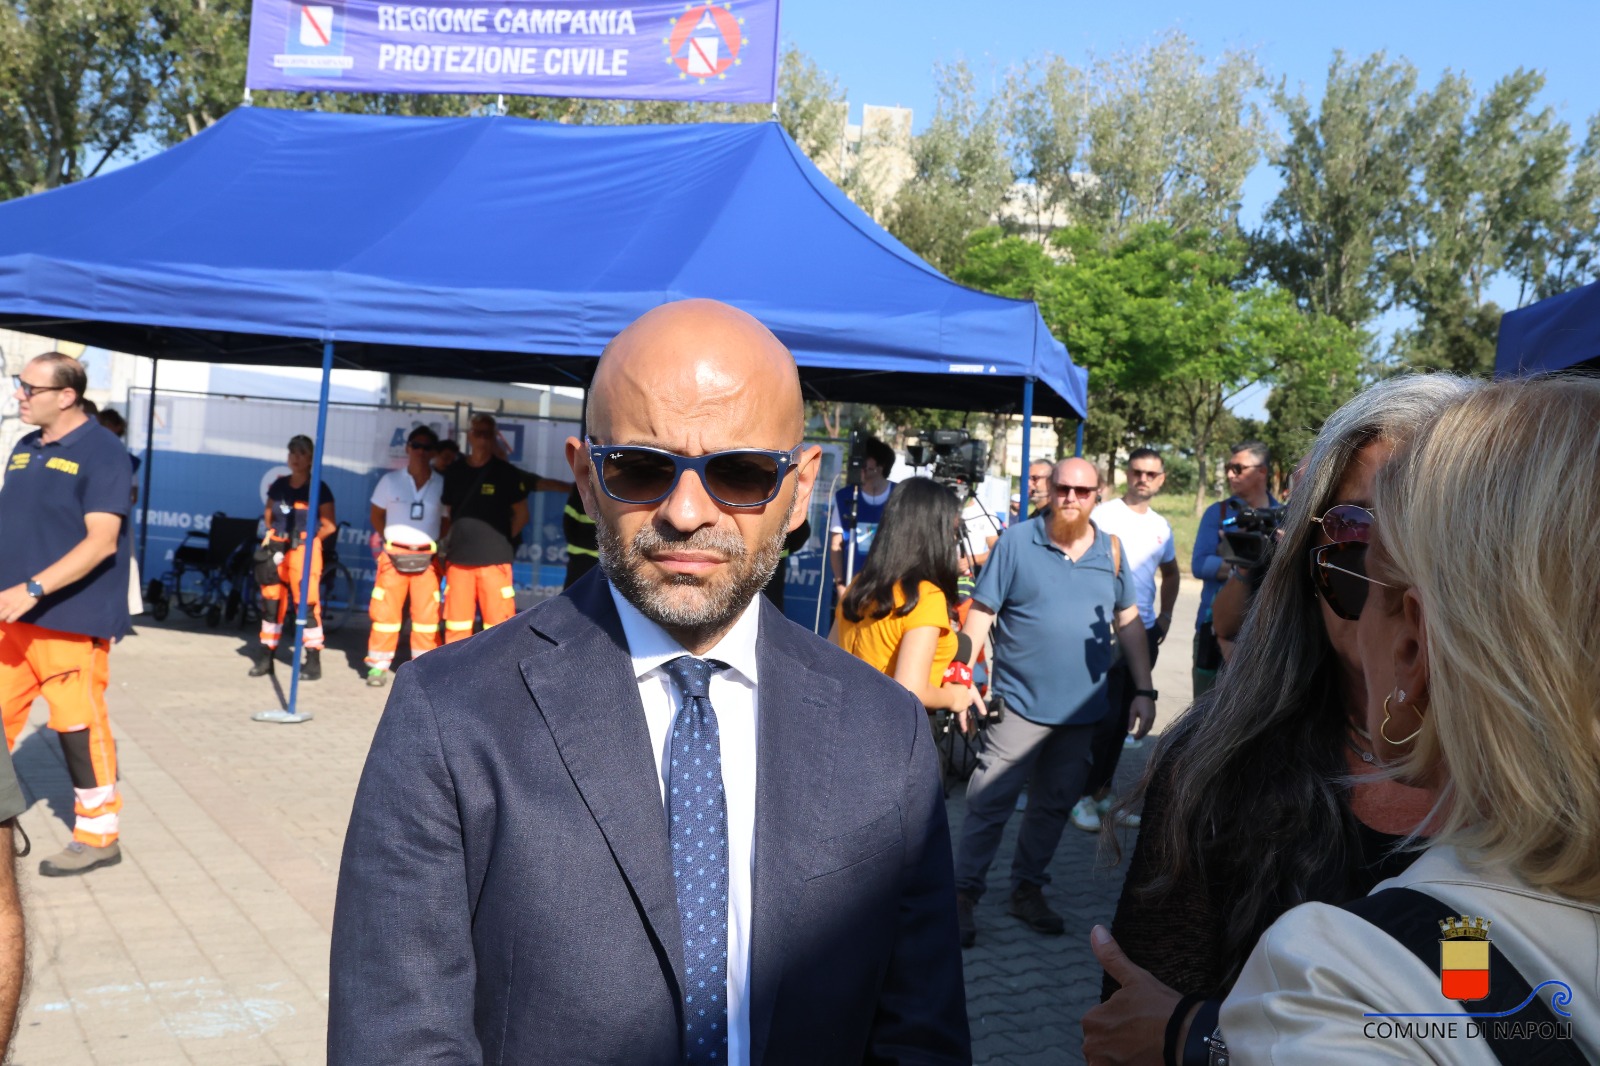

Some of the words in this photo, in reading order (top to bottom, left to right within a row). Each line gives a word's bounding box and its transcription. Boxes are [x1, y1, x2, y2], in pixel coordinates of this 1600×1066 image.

[378, 5, 489, 33] REGIONE
[493, 7, 636, 35] CAMPANIA
[378, 43, 537, 74] PROTEZIONE
[544, 47, 629, 76] CIVILE
